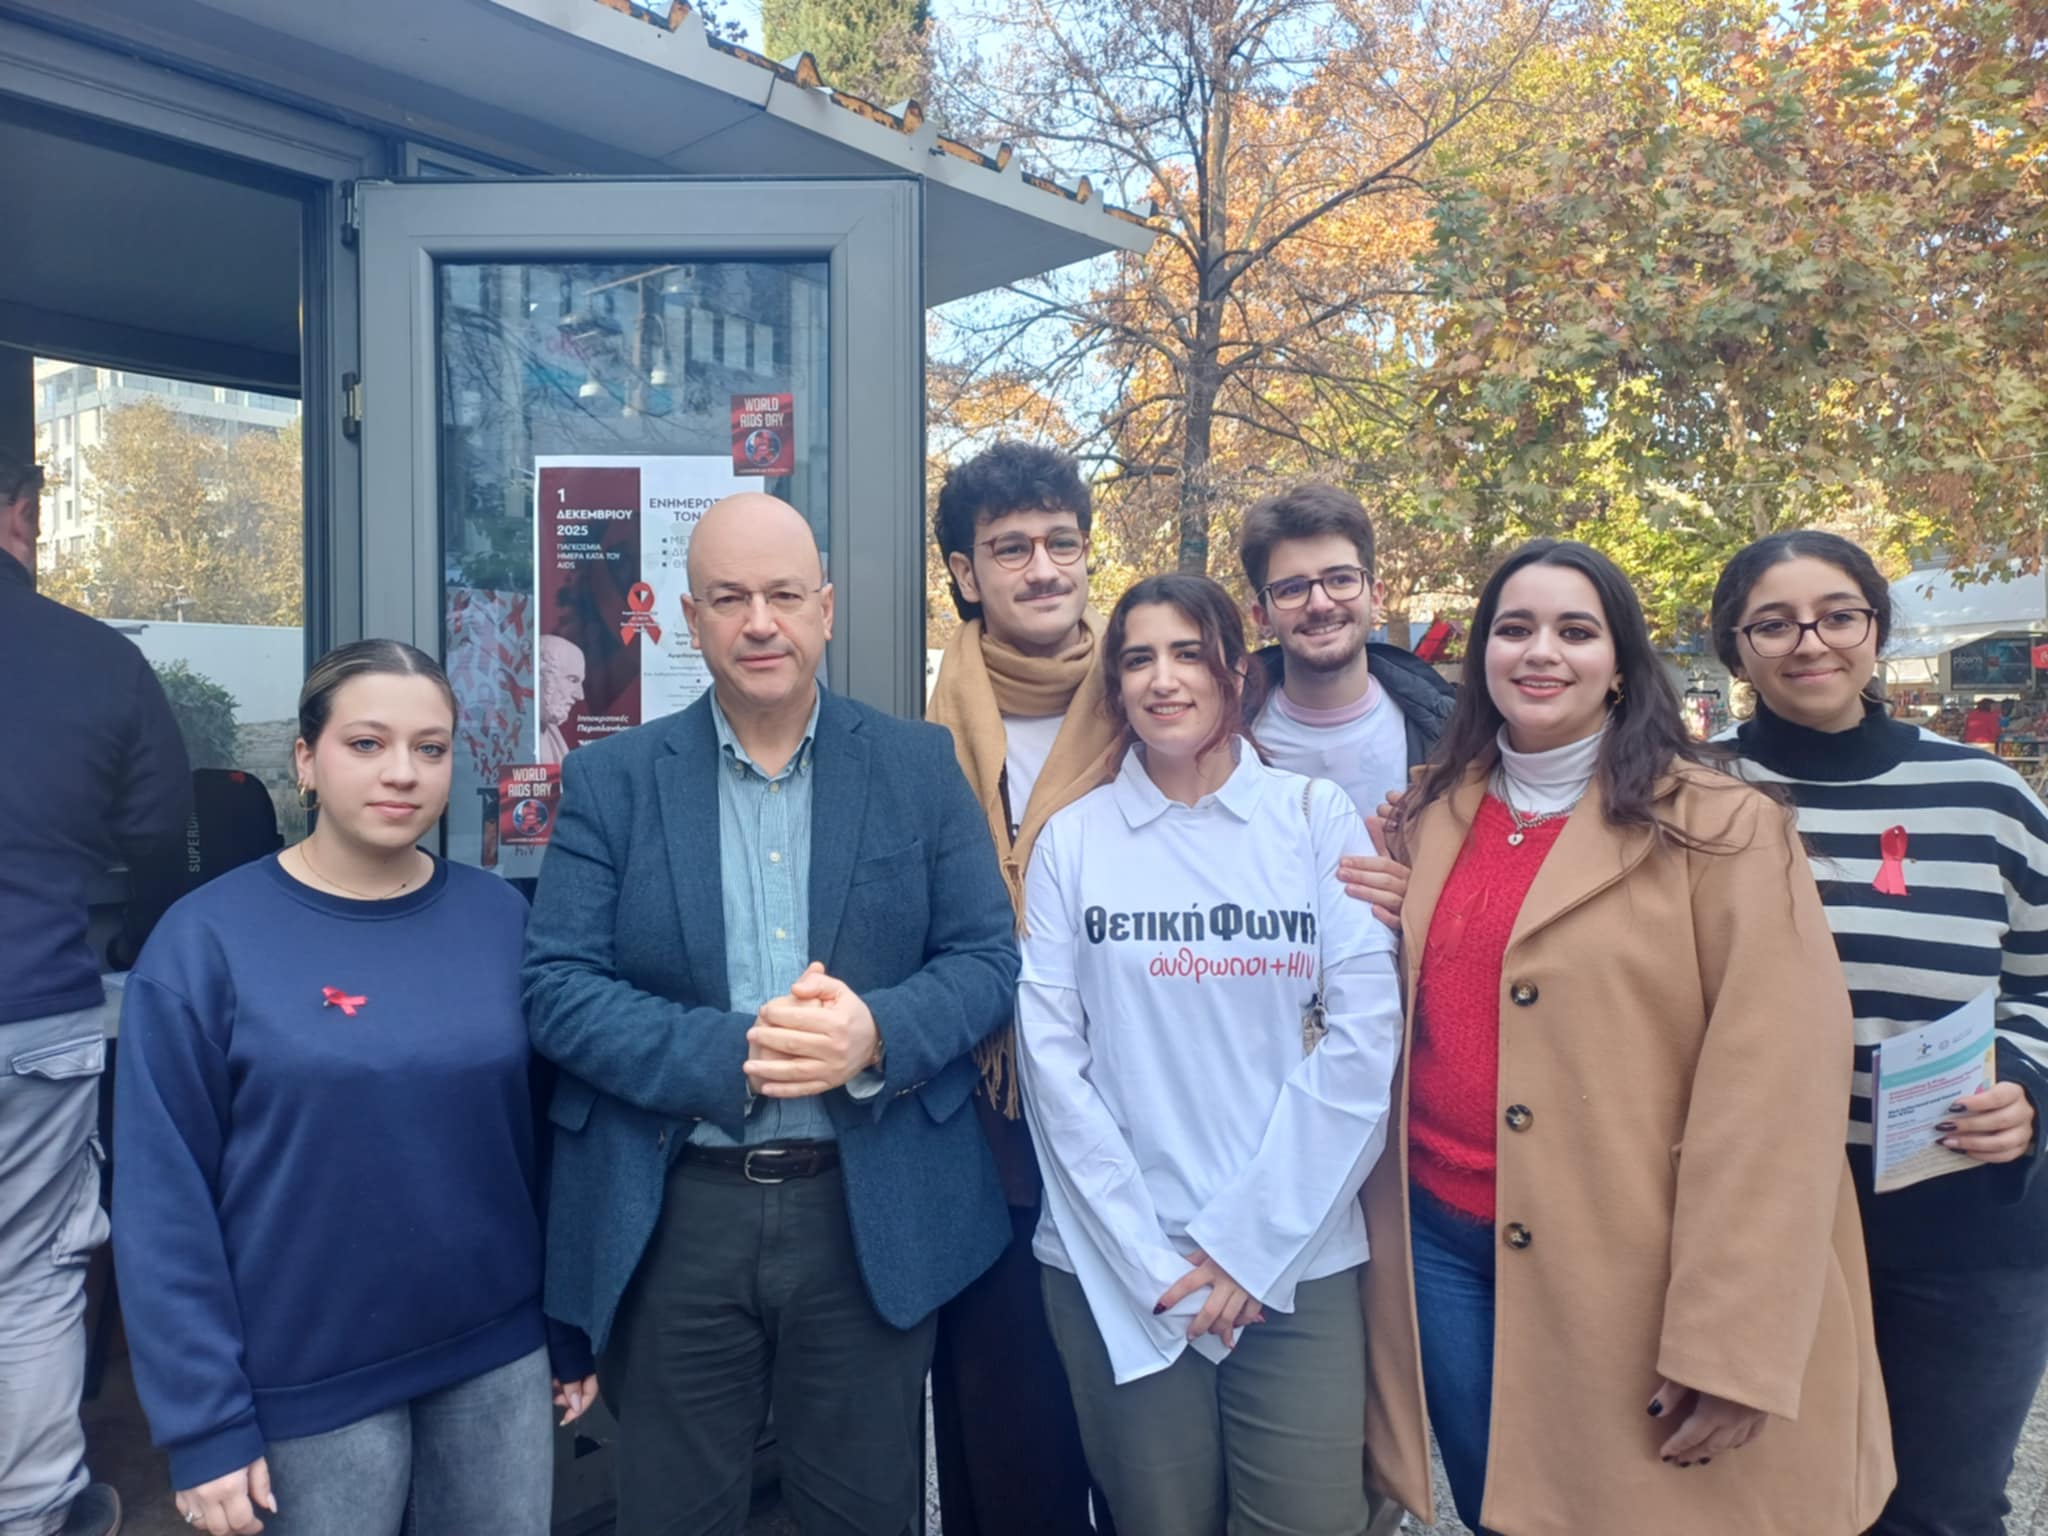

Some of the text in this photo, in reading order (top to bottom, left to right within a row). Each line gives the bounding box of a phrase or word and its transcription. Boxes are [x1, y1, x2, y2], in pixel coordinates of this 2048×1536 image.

[744, 397, 779, 411] WORLD
[740, 412, 784, 427] AIDS DAY
[557, 488, 565, 502] 1
[556, 509, 633, 520] ΔΕΚΕΜΒΡΙΟΥ
[556, 525, 588, 536] 2025
[556, 543, 602, 551] ΠΑΓΚΟΣΜΙΑ
[556, 552, 585, 560] ΗΜΕΡΑ
[606, 552, 621, 560] ΤΟΥ
[556, 561, 576, 569] AIDS
[512, 767, 548, 781] WORLD
[507, 782, 552, 797] AIDS DAY
